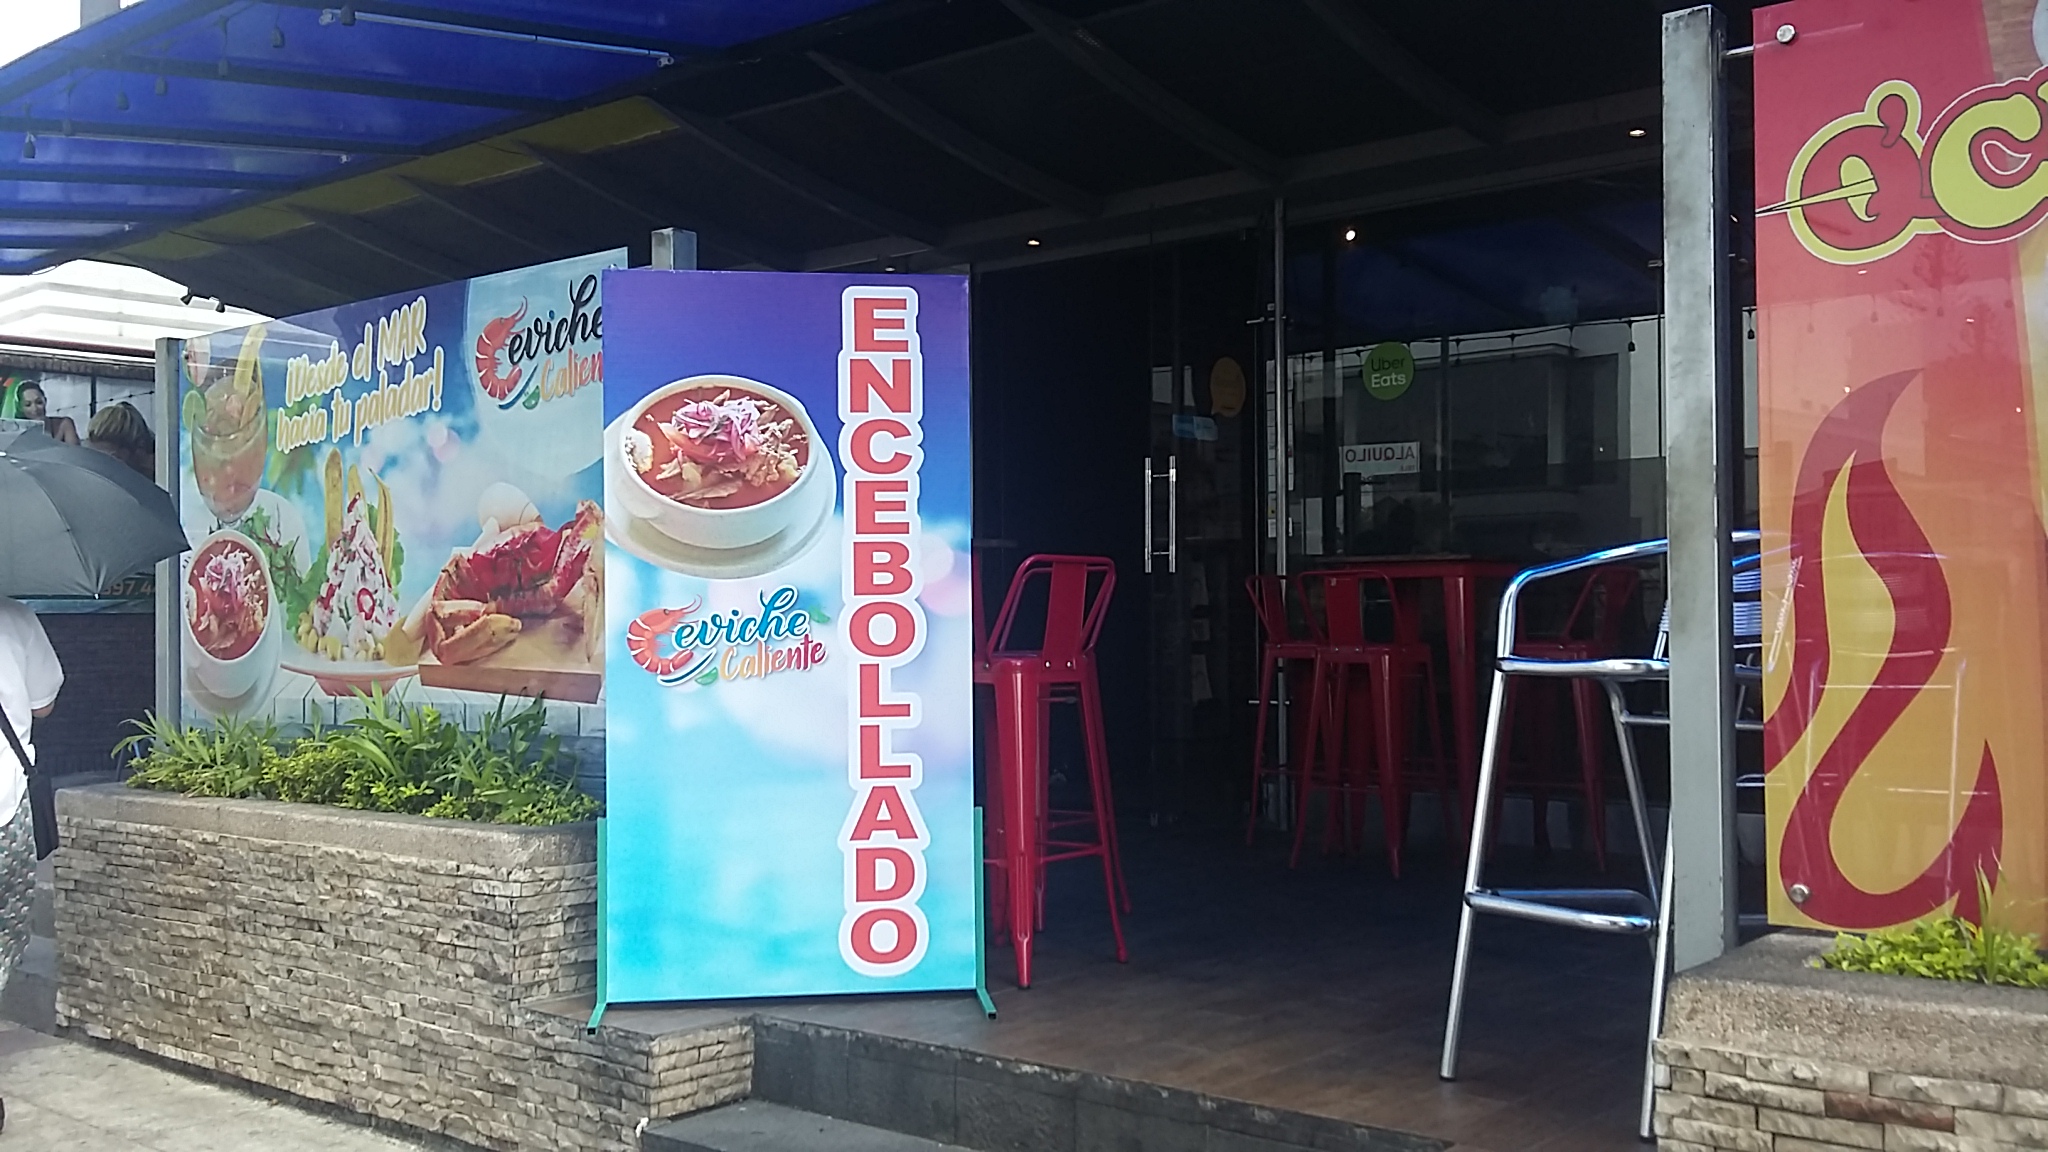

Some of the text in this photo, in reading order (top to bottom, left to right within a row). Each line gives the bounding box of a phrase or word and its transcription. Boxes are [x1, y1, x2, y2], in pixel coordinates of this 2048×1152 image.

[352, 323, 372, 381] el
[377, 296, 426, 371] MAR
[1371, 357, 1405, 372] Uber
[276, 346, 444, 453] hacia tu paladar!
[541, 348, 603, 401] Calien
[1371, 373, 1407, 388] Eats
[719, 634, 827, 680] Caliente
[847, 298, 921, 965] ENCEBOLLADO
